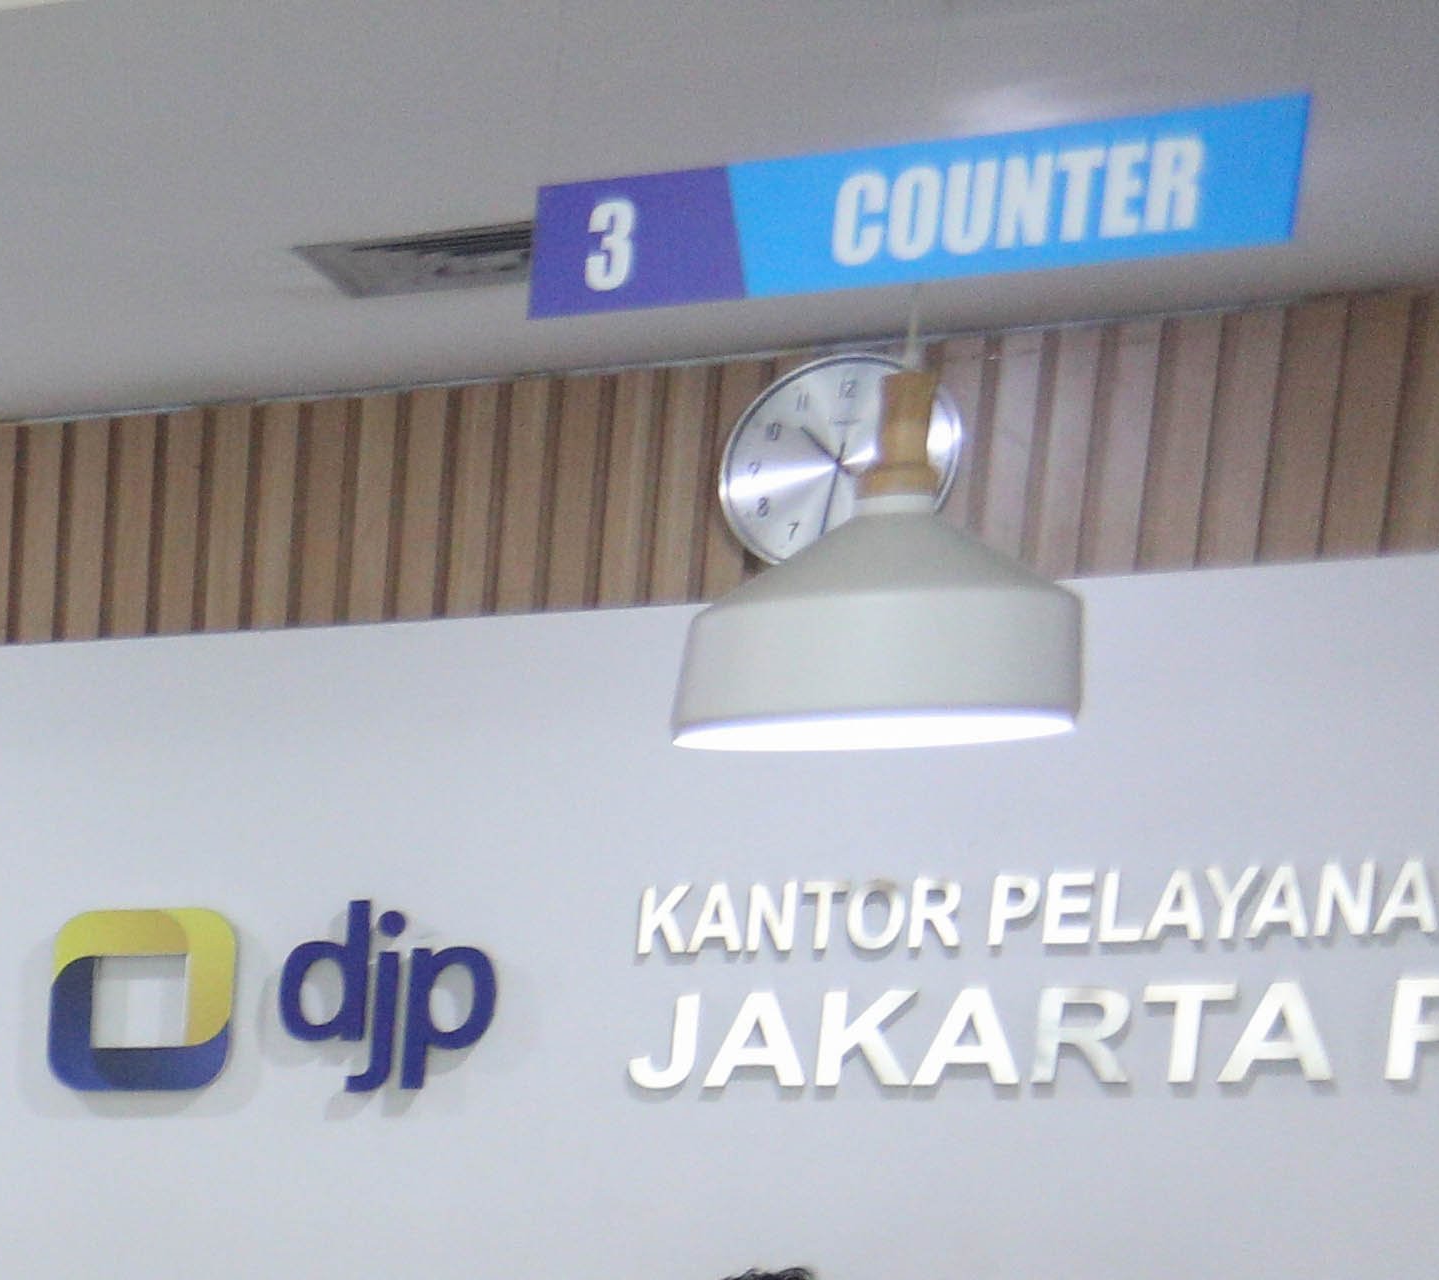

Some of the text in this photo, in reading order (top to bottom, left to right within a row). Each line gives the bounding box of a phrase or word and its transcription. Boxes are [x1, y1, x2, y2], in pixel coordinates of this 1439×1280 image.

[584, 135, 1205, 292] 3 COUNTER
[637, 858, 1439, 955] KANTOR PELAYANA
[279, 899, 497, 1092] djp
[628, 981, 1335, 1089] JAKARTA
